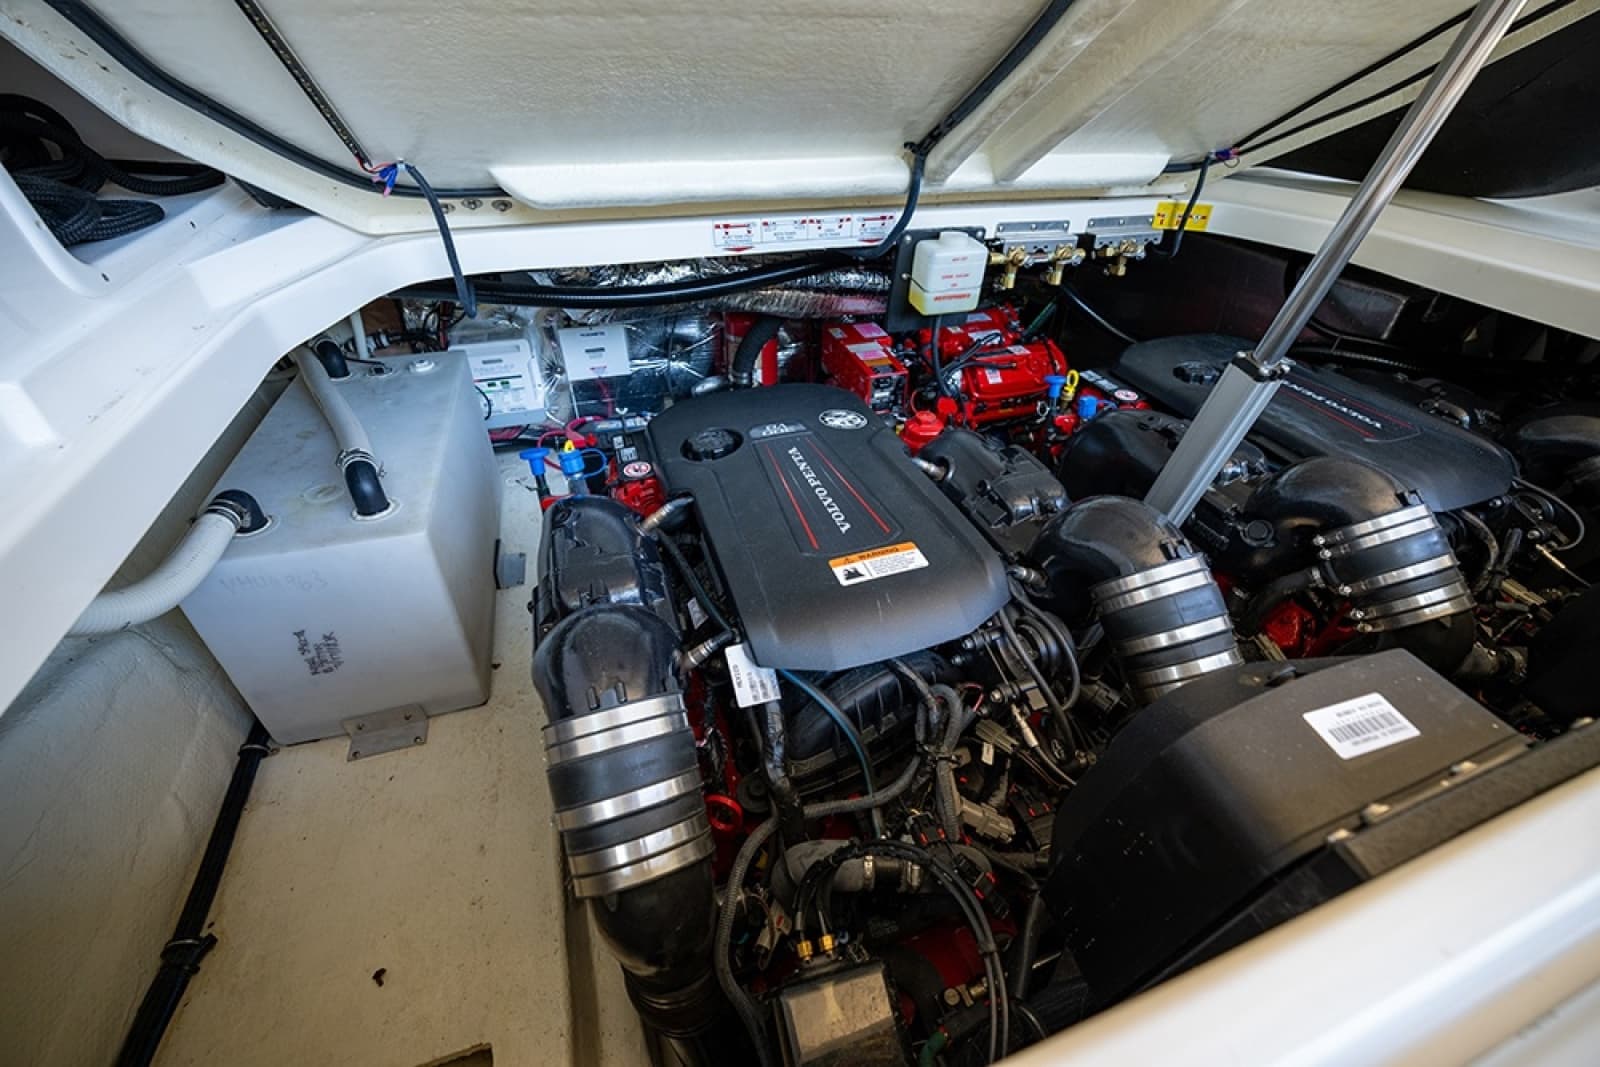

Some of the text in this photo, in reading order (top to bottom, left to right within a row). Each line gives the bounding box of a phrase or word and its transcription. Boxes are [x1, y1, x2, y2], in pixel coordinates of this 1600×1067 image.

[787, 446, 851, 534] VOLVO PENTA
[858, 547, 900, 560] WARNING
